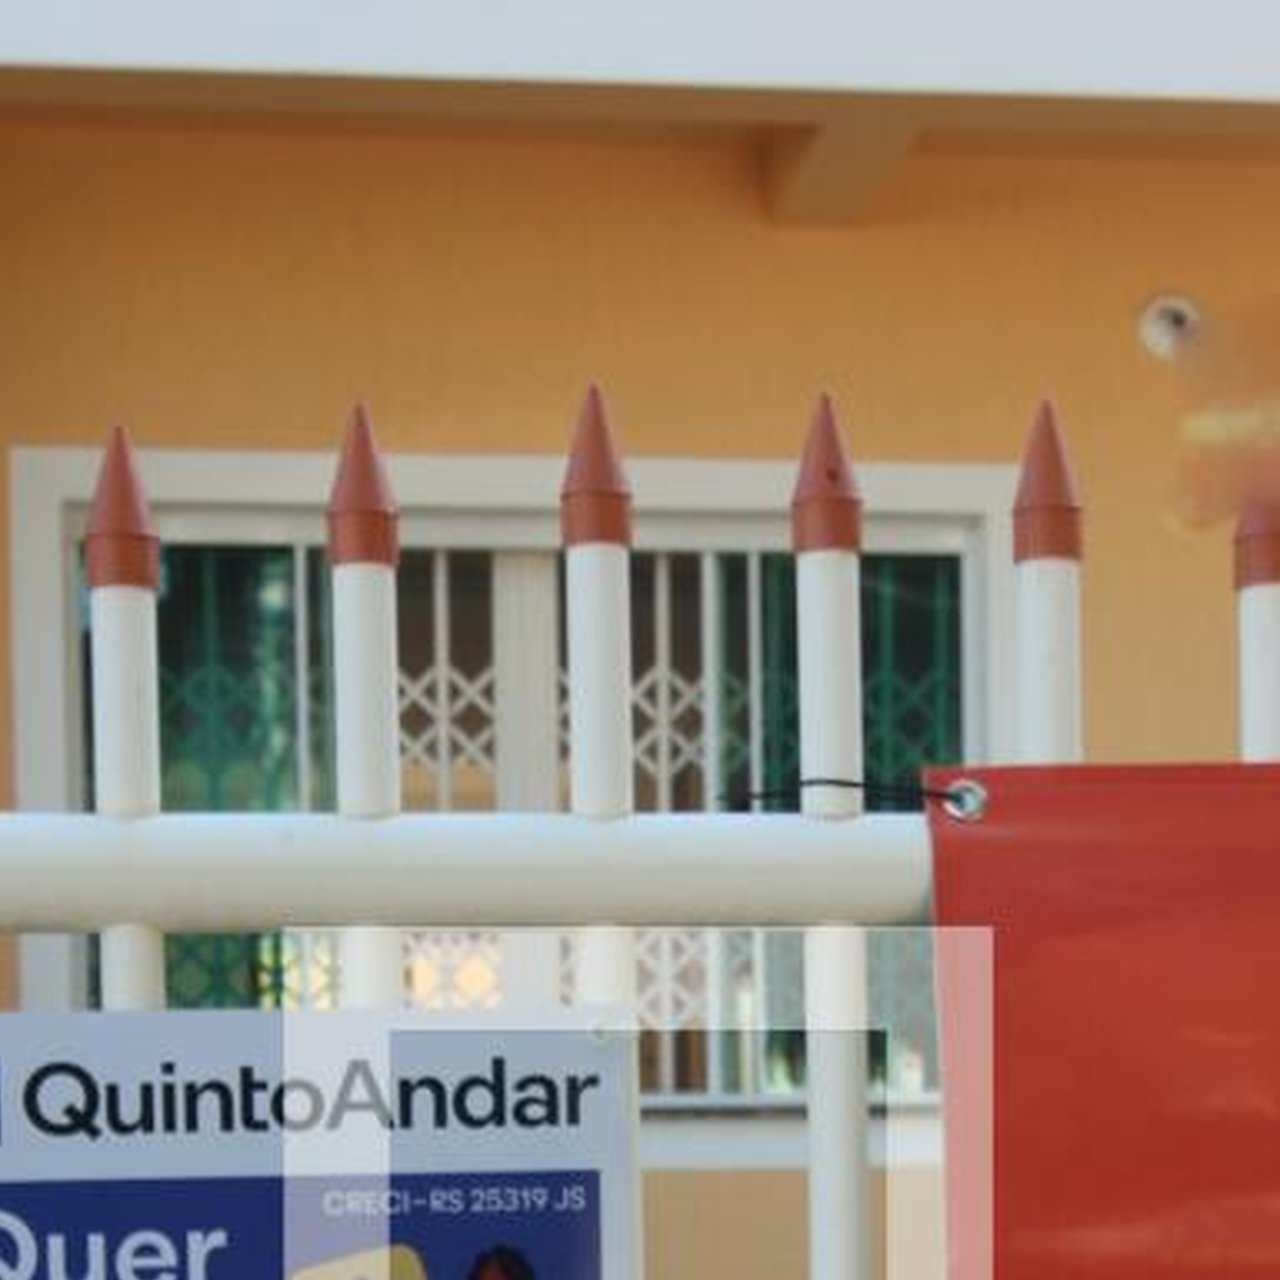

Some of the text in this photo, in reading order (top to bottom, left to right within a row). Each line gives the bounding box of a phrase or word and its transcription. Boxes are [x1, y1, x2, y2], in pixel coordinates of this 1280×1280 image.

[22, 1056, 600, 1140] QuintoAndar
[470, 1186, 548, 1213] 25319
[553, 1185, 587, 1213] JS
